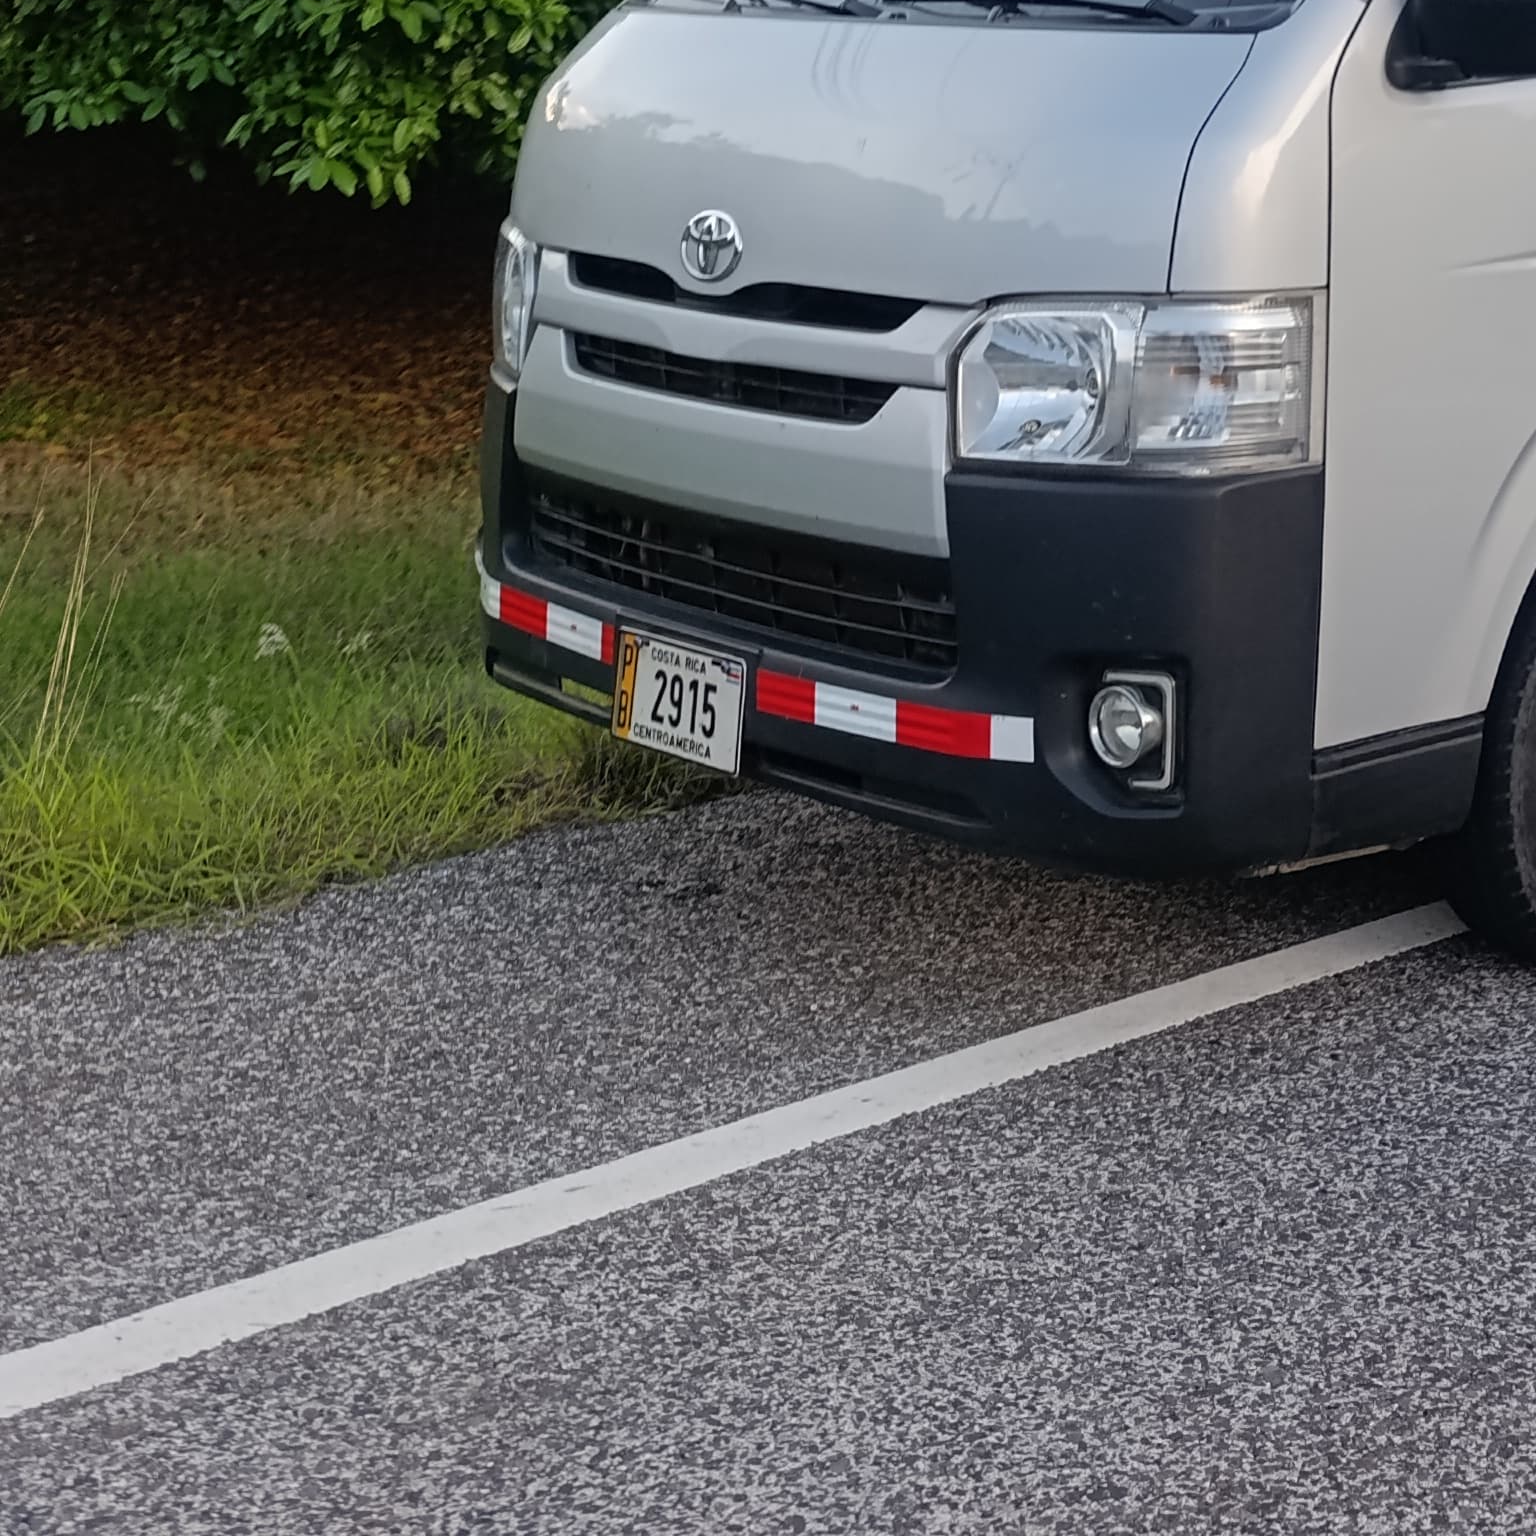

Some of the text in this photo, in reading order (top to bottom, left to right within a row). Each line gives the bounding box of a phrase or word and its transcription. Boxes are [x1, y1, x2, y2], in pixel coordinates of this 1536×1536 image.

[651, 647, 707, 675] COSTA RICA
[651, 669, 717, 739] 2915
[633, 722, 711, 759] CENTROAMERICA
